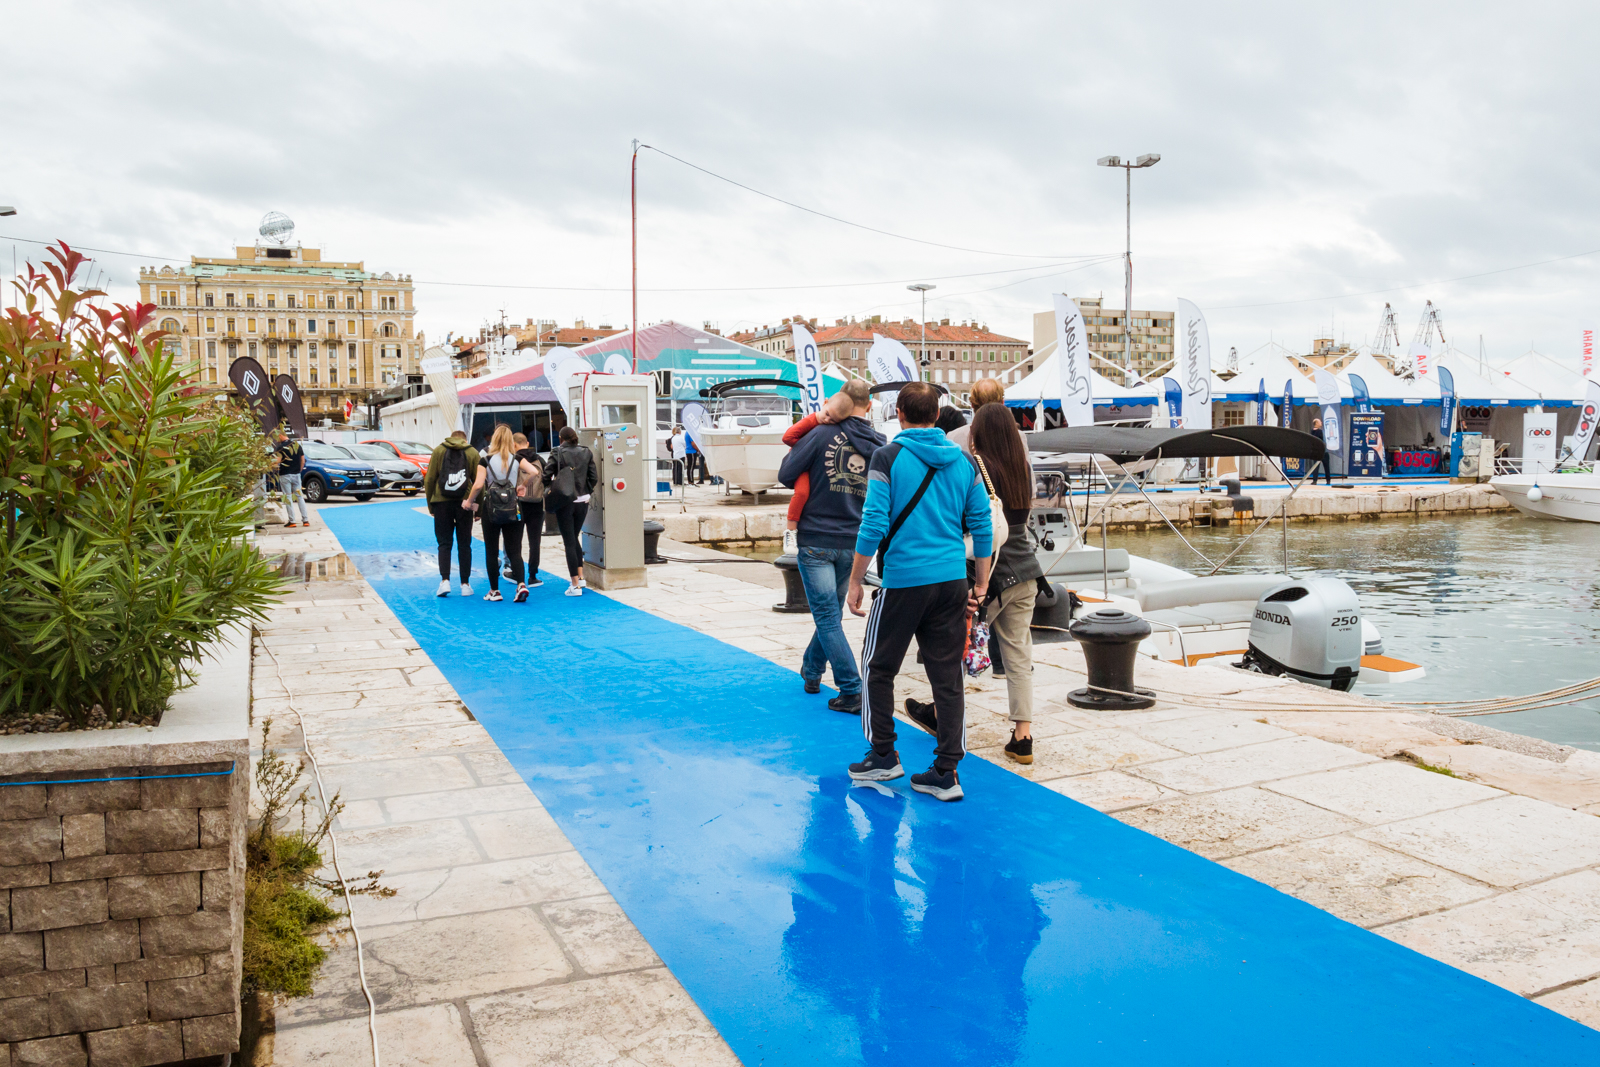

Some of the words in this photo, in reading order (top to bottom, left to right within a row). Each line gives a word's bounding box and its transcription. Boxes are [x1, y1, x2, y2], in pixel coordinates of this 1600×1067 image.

[672, 376, 702, 390] OAT
[1528, 428, 1551, 436] roto
[1394, 451, 1440, 468] BOSCH
[448, 468, 466, 485] NIKE
[1255, 609, 1292, 626] HONDA
[1331, 615, 1358, 627] 250
